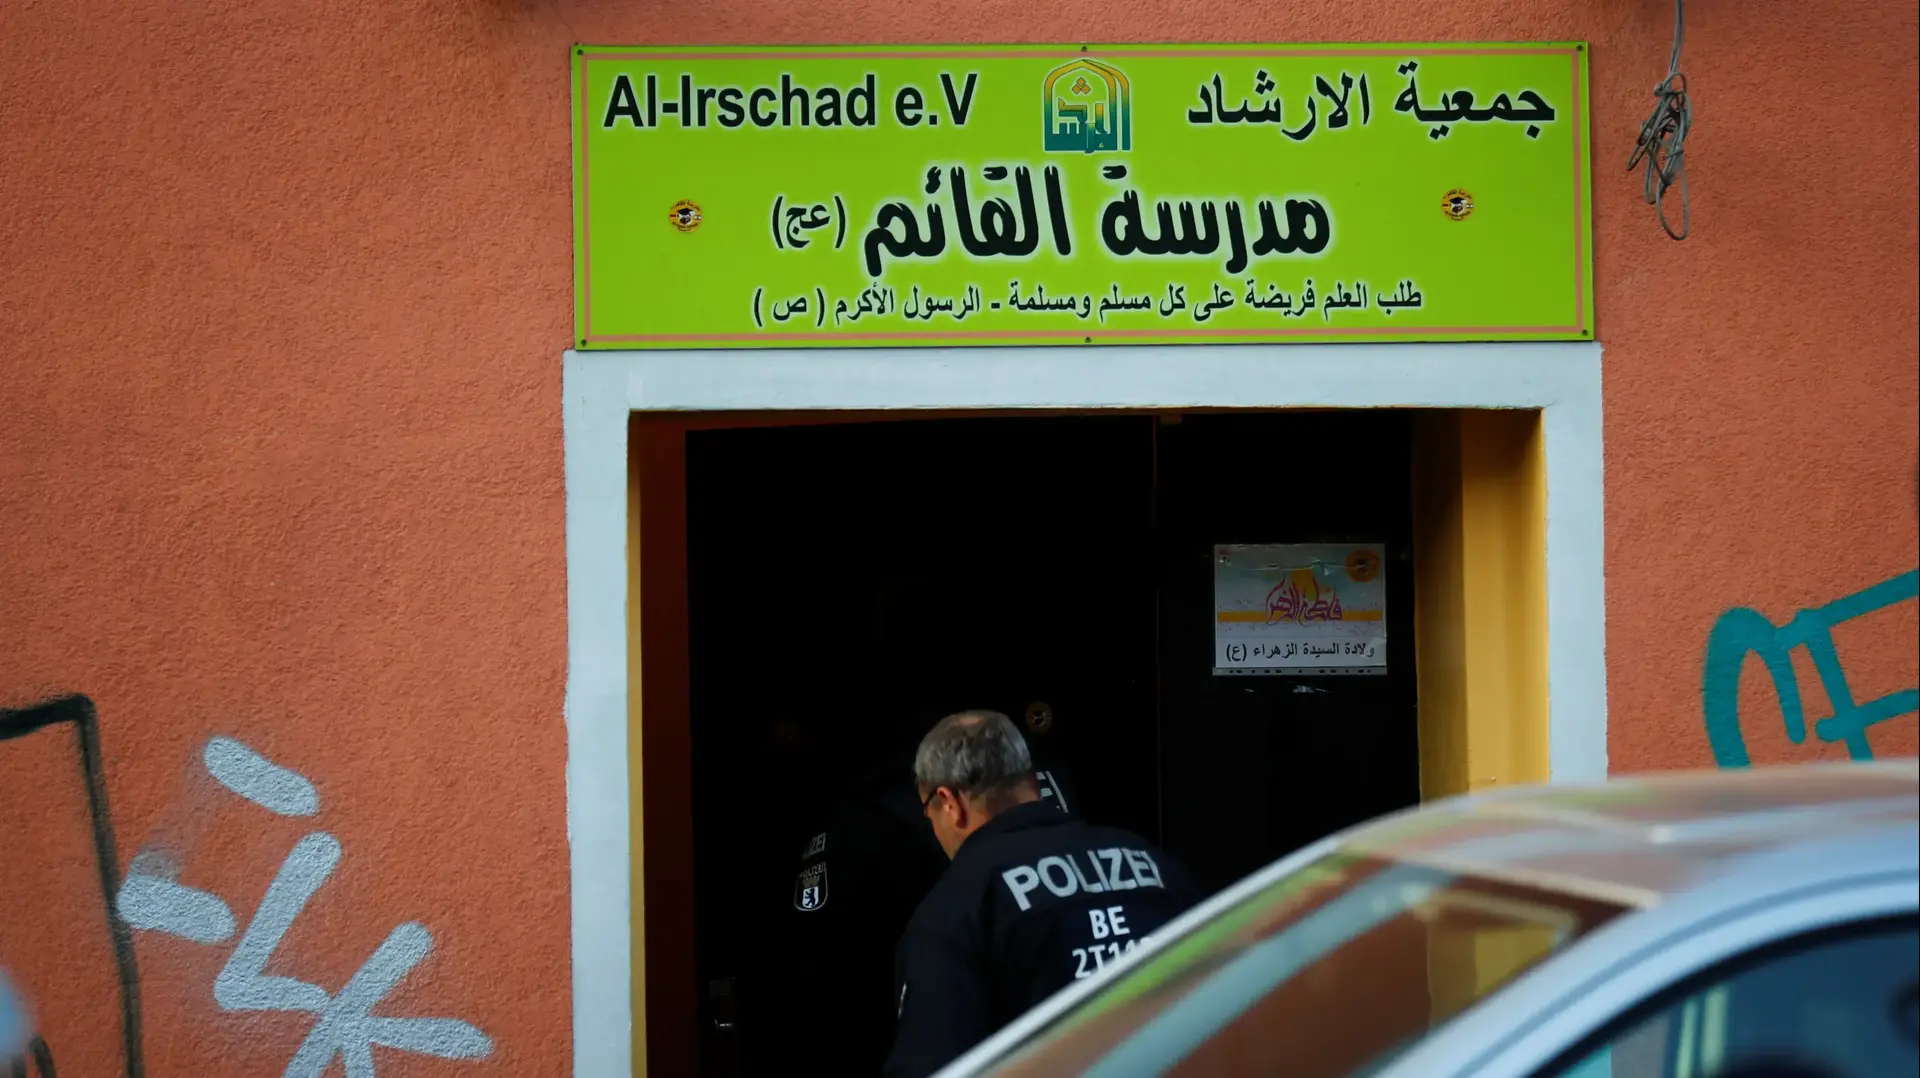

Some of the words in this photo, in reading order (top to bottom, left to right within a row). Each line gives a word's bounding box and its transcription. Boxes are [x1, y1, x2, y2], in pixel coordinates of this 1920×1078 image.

[603, 74, 876, 128] Al-Irschad
[895, 73, 978, 126] e.V
[1188, 70, 1370, 141] الارشاد
[1394, 61, 1555, 140] جمعية
[864, 165, 1072, 277] القائم
[1101, 165, 1330, 274] مدرسة
[835, 282, 894, 324] الأكرم
[904, 286, 980, 320] الرسول
[1008, 280, 1090, 319] ومسلمة
[1099, 284, 1151, 322] مسلم
[1159, 284, 1186, 317] كل
[1194, 283, 1234, 322] على
[1245, 279, 1315, 317] فريضة
[1323, 282, 1367, 321] العلم
[1377, 280, 1422, 315] طلب
[1253, 642, 1298, 659] الزهراء
[1303, 642, 1340, 659] السيدة
[1344, 641, 1375, 658] ولادة
[1002, 847, 1164, 912] POLIZEI
[1088, 905, 1131, 940] BE
